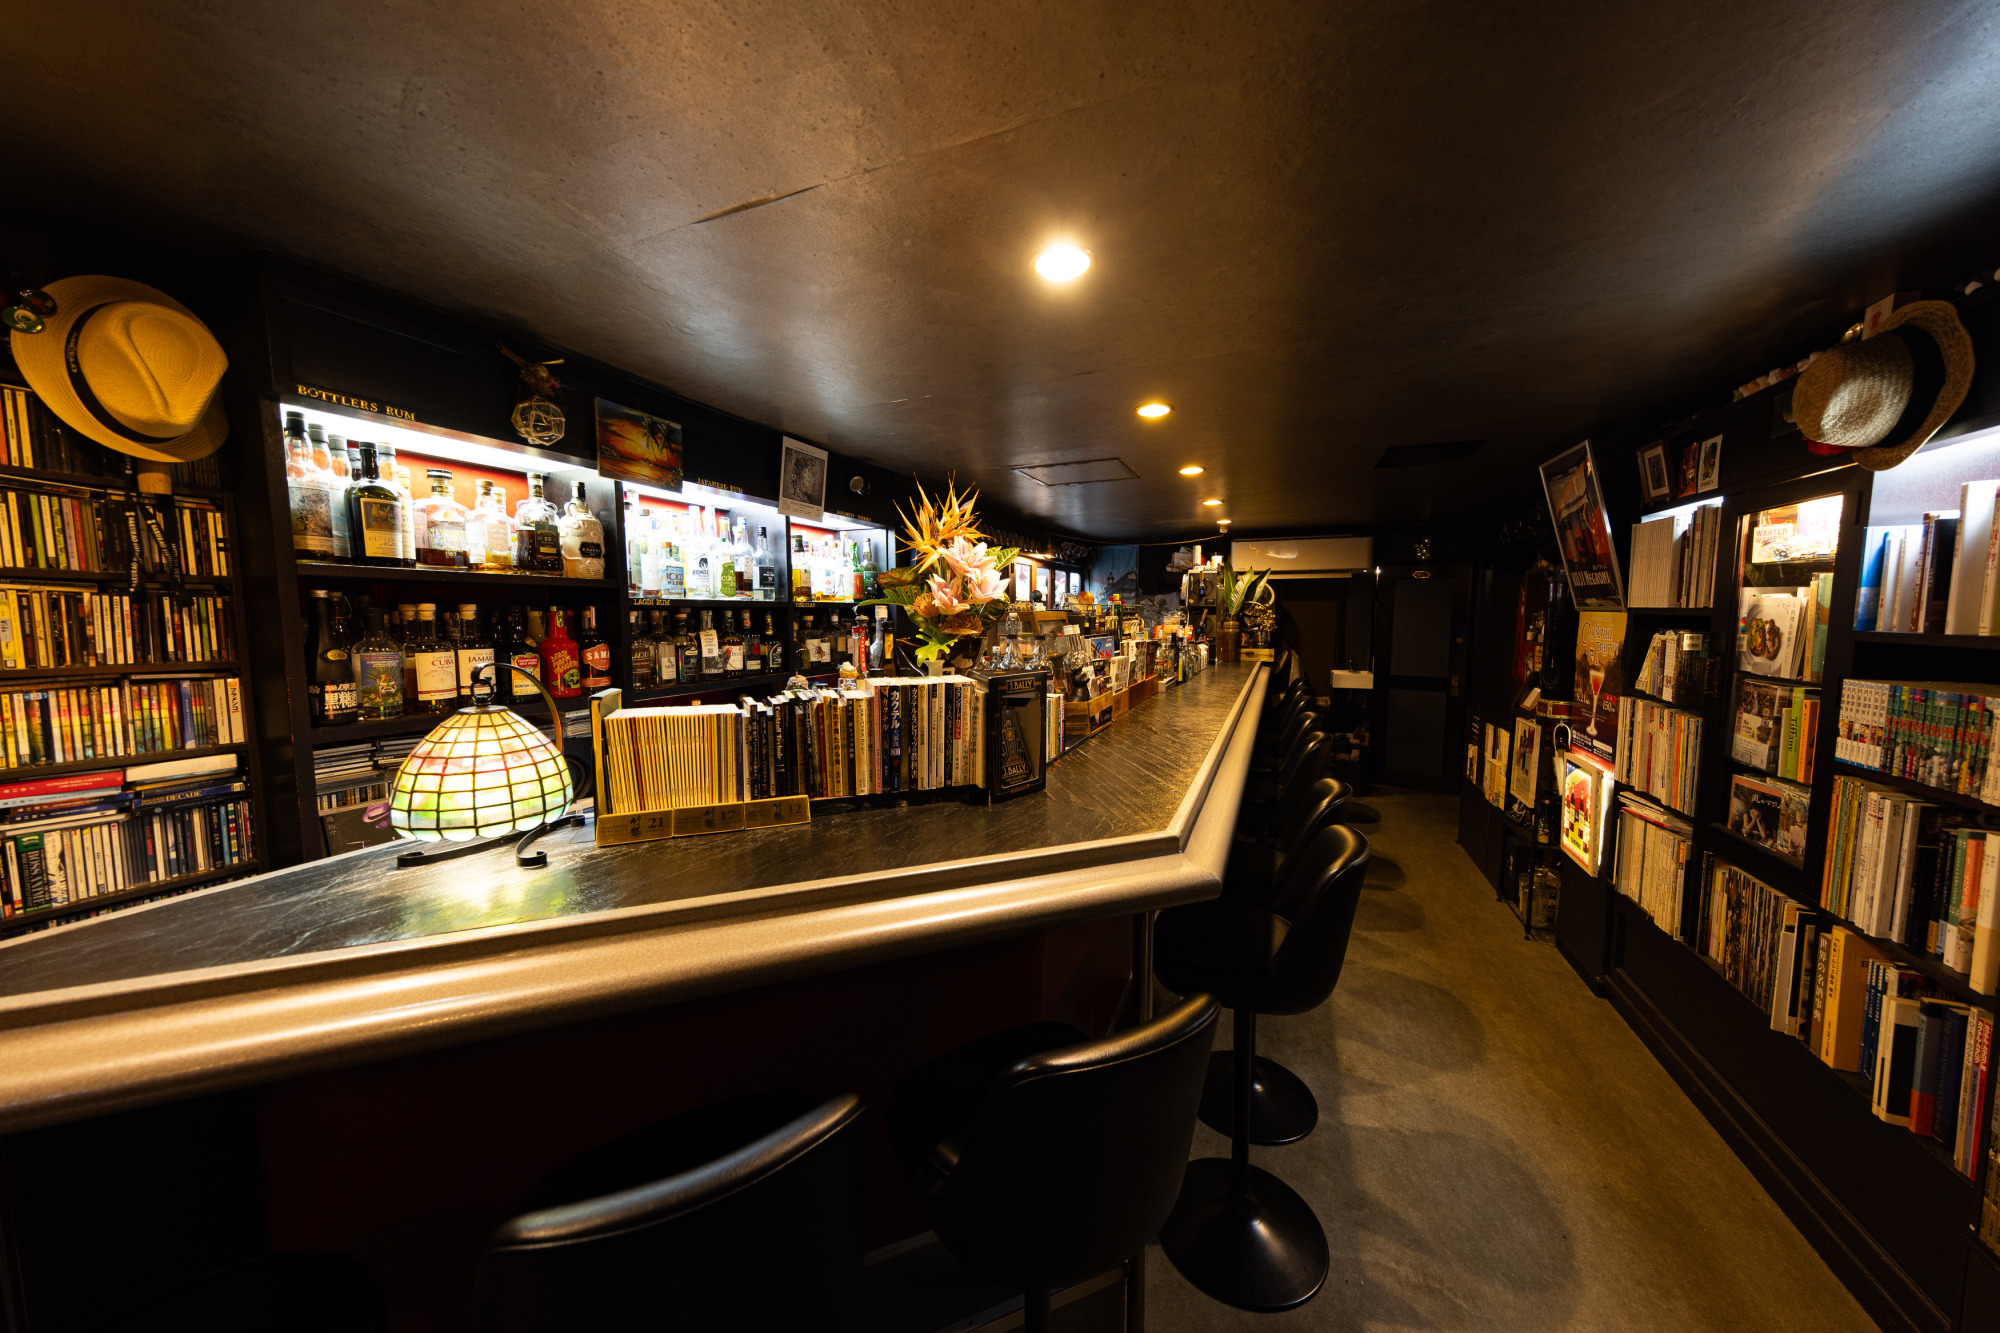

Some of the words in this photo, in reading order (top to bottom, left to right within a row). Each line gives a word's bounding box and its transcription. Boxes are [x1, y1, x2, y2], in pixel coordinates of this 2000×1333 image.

[297, 384, 378, 412] BOTTLERS
[385, 405, 416, 421] RUM
[697, 477, 728, 490] JAPANESE
[1756, 528, 1788, 537] WANTED
[1584, 571, 1612, 586] NEGRONI
[656, 598, 671, 606] RUM
[1582, 621, 1614, 645] Cocktail
[431, 658, 454, 666] CUBA
[1009, 679, 1033, 691] J.BALLY
[775, 706, 783, 733] Cocktail
[1789, 716, 1798, 752] Tiffany
[1003, 763, 1026, 777] J.BALLY
[166, 790, 202, 802] DECADE
[788, 803, 802, 815] 12
[721, 810, 736, 821] 17
[648, 817, 664, 829] 21
[1813, 937, 1828, 1022] 世界の名酒事典
